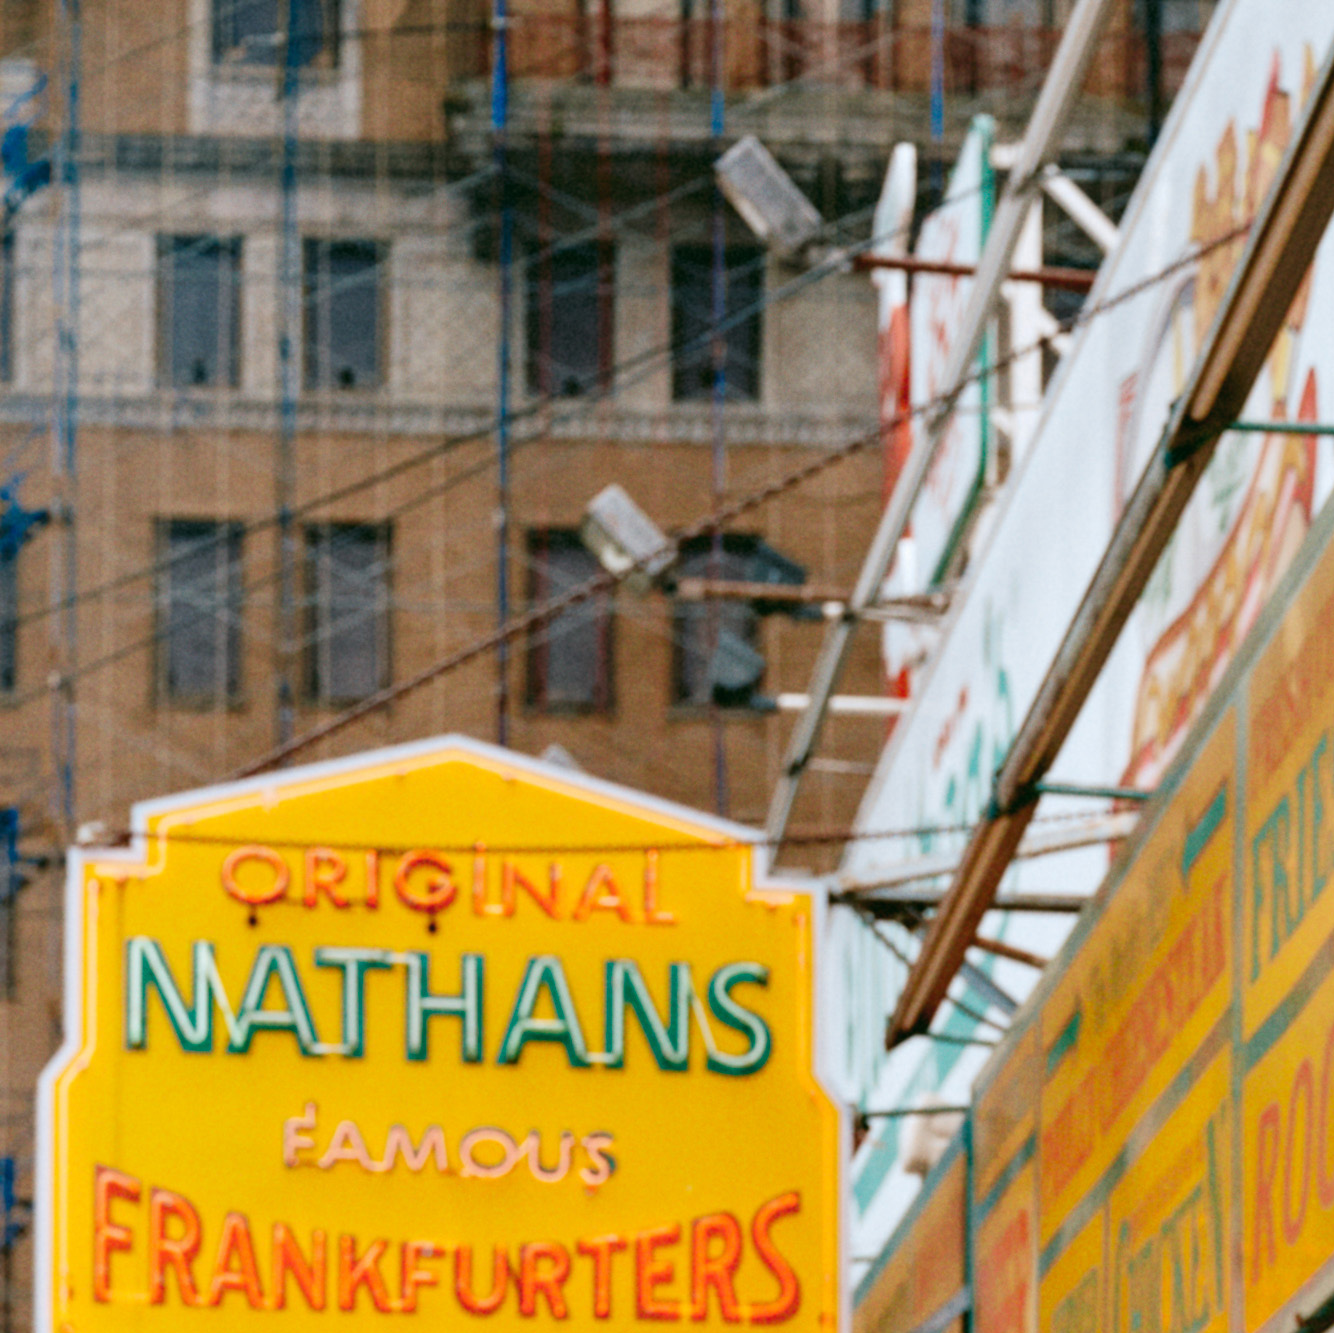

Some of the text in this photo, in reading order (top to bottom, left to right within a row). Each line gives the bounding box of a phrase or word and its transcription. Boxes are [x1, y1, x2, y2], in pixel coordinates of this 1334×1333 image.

[221, 843, 677, 925] ORIGINAL
[125, 937, 772, 1077] NATHANS
[283, 1108, 617, 1187] FAMOUS
[93, 1164, 802, 1326] FRANKFURTERS
